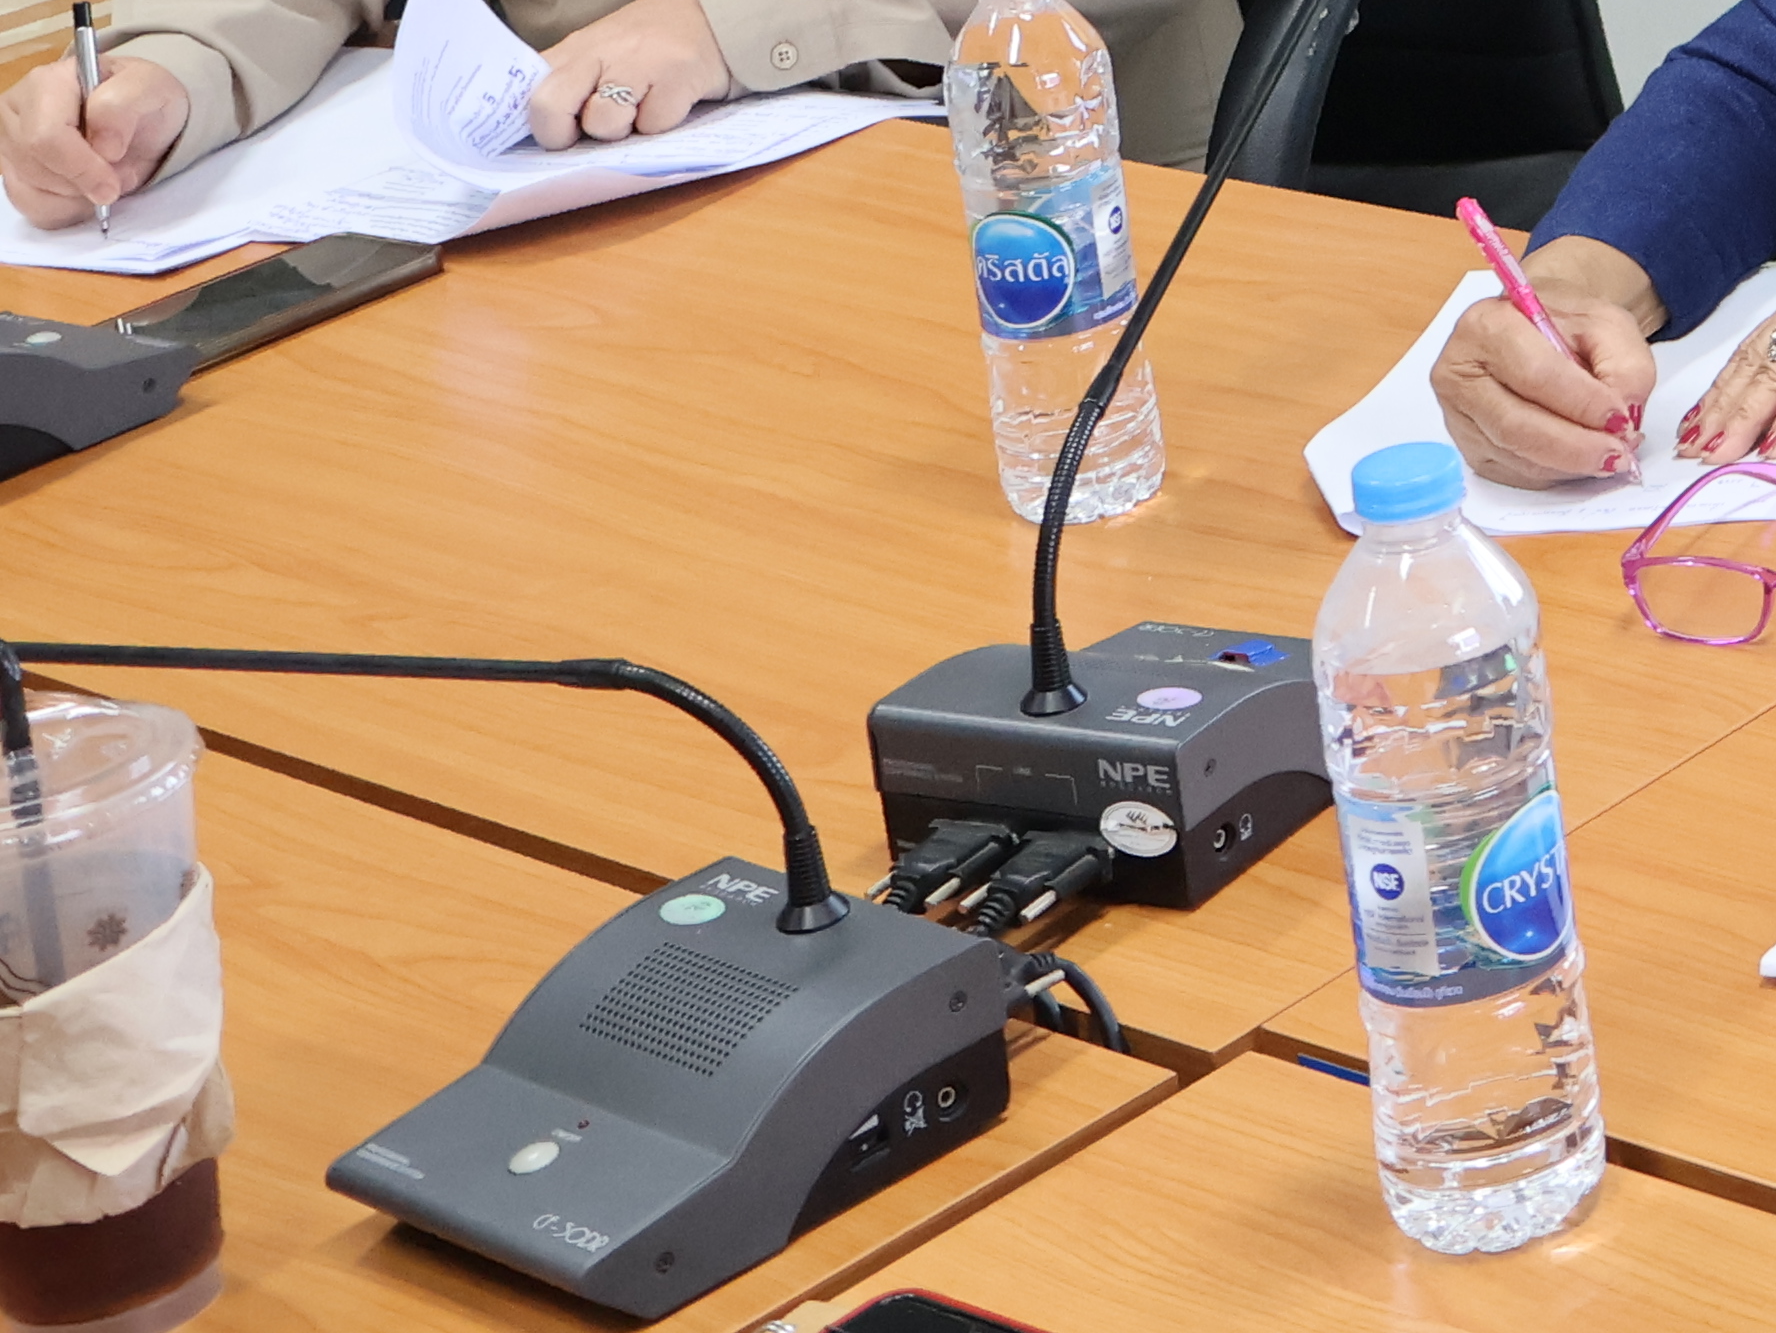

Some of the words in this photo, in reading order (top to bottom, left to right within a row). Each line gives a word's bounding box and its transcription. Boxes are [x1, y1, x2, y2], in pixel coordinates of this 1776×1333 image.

[1106, 706, 1191, 728] NPE
[1097, 759, 1171, 789] NPE
[706, 873, 780, 904] NPE
